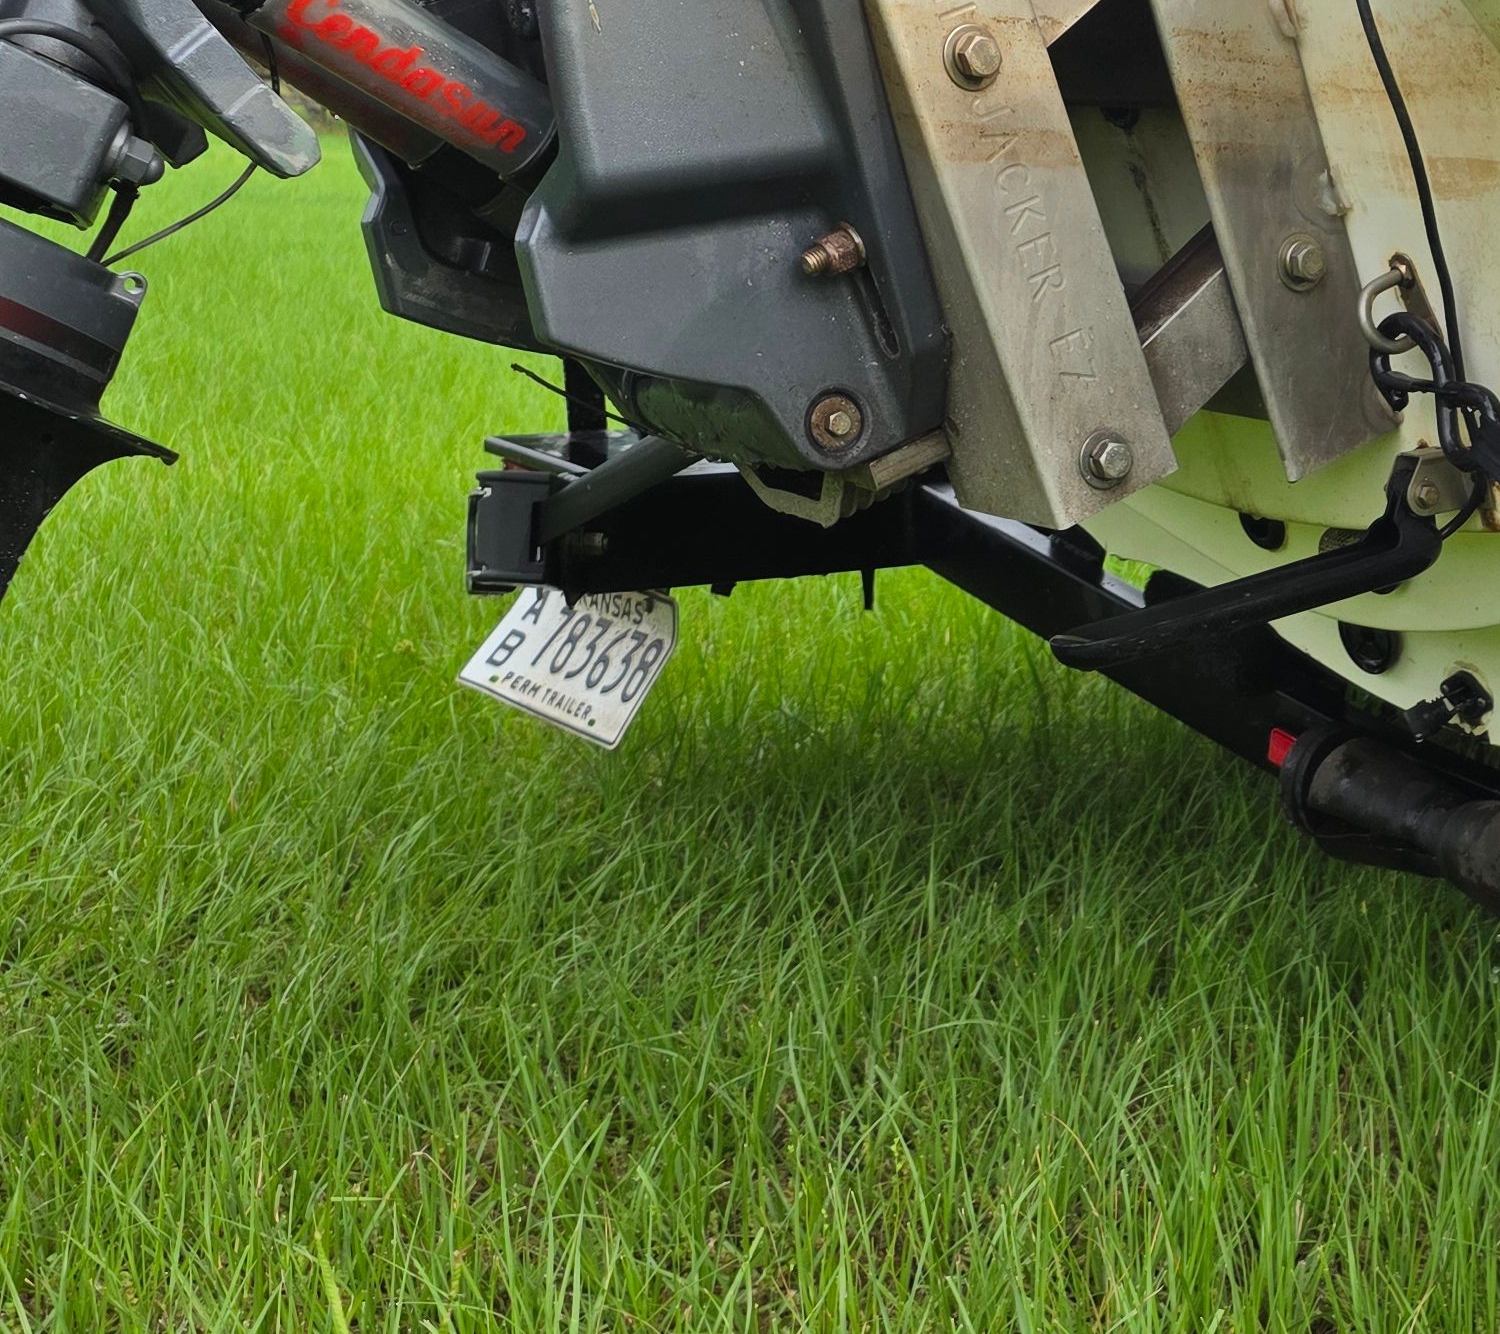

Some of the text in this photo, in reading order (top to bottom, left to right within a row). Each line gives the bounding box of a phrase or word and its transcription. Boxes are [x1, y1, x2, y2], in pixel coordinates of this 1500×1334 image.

[971, 96, 1066, 303] JACKER
[501, 670, 593, 721] PERM TRAILER
[531, 606, 664, 703] 783638
